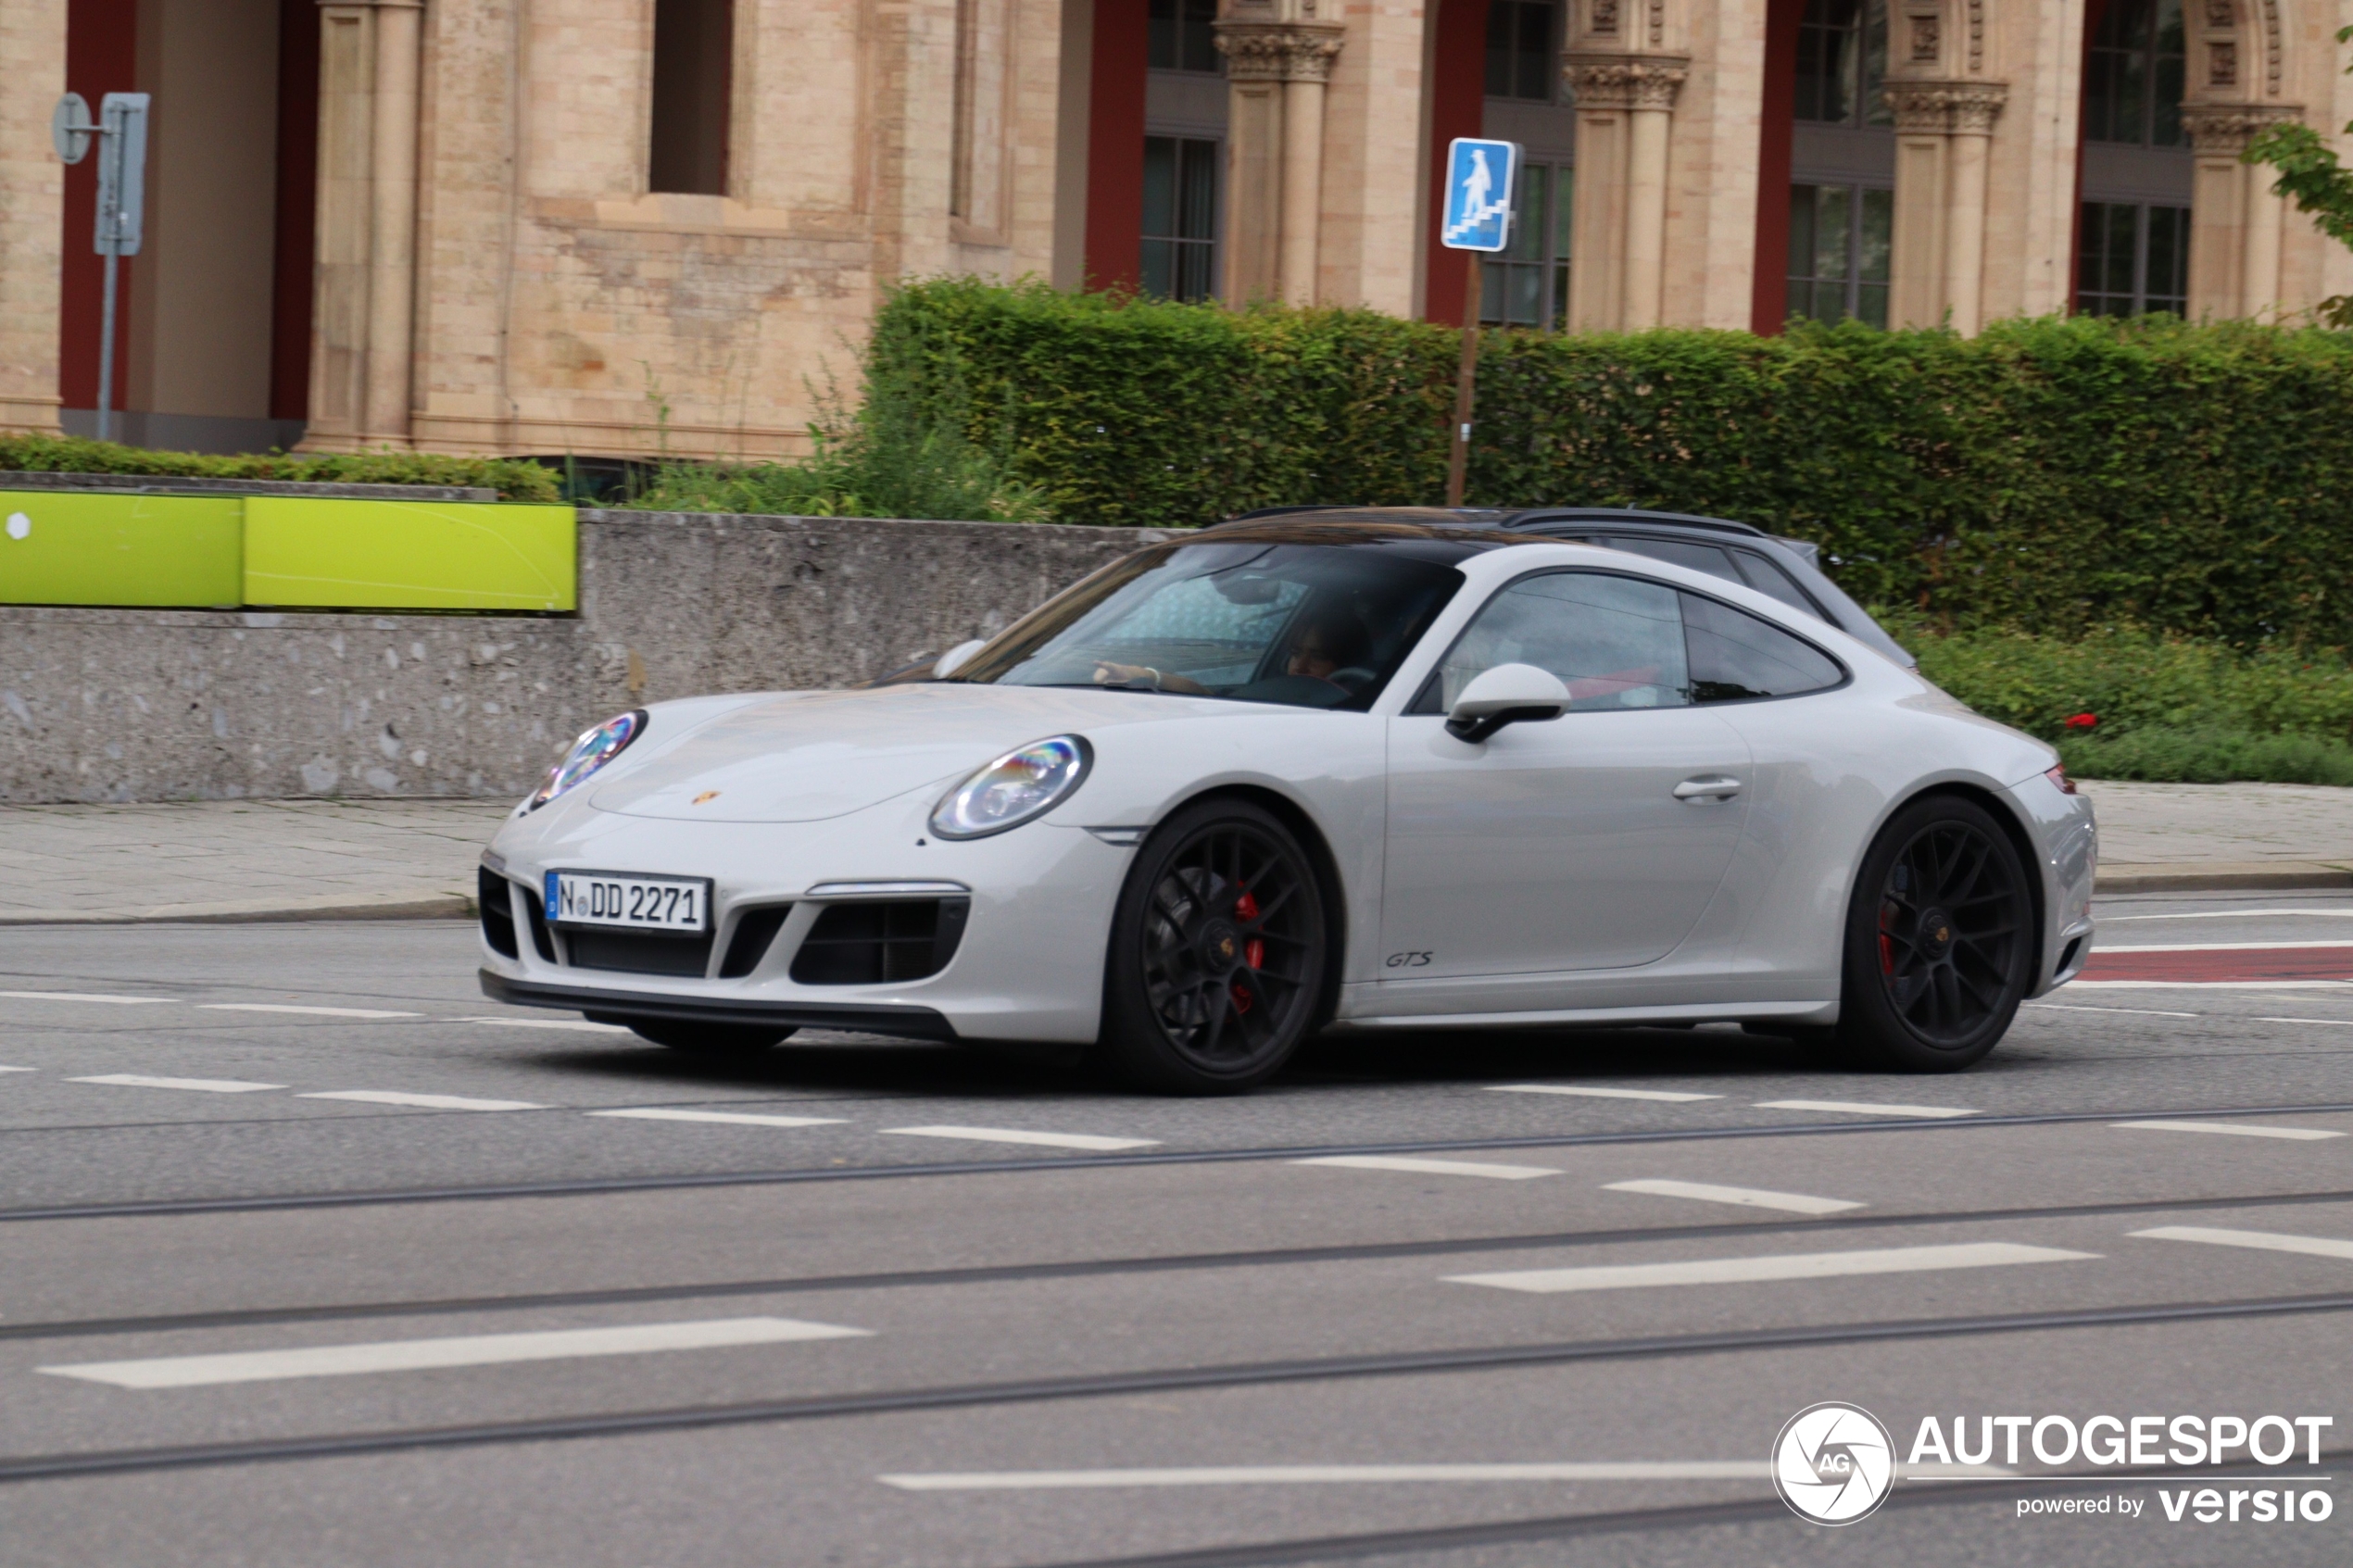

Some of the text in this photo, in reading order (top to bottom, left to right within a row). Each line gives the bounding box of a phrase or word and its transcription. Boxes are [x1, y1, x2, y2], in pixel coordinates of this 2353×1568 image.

[560, 881, 698, 923] N DD 2271
[1386, 951, 1433, 967] GTS
